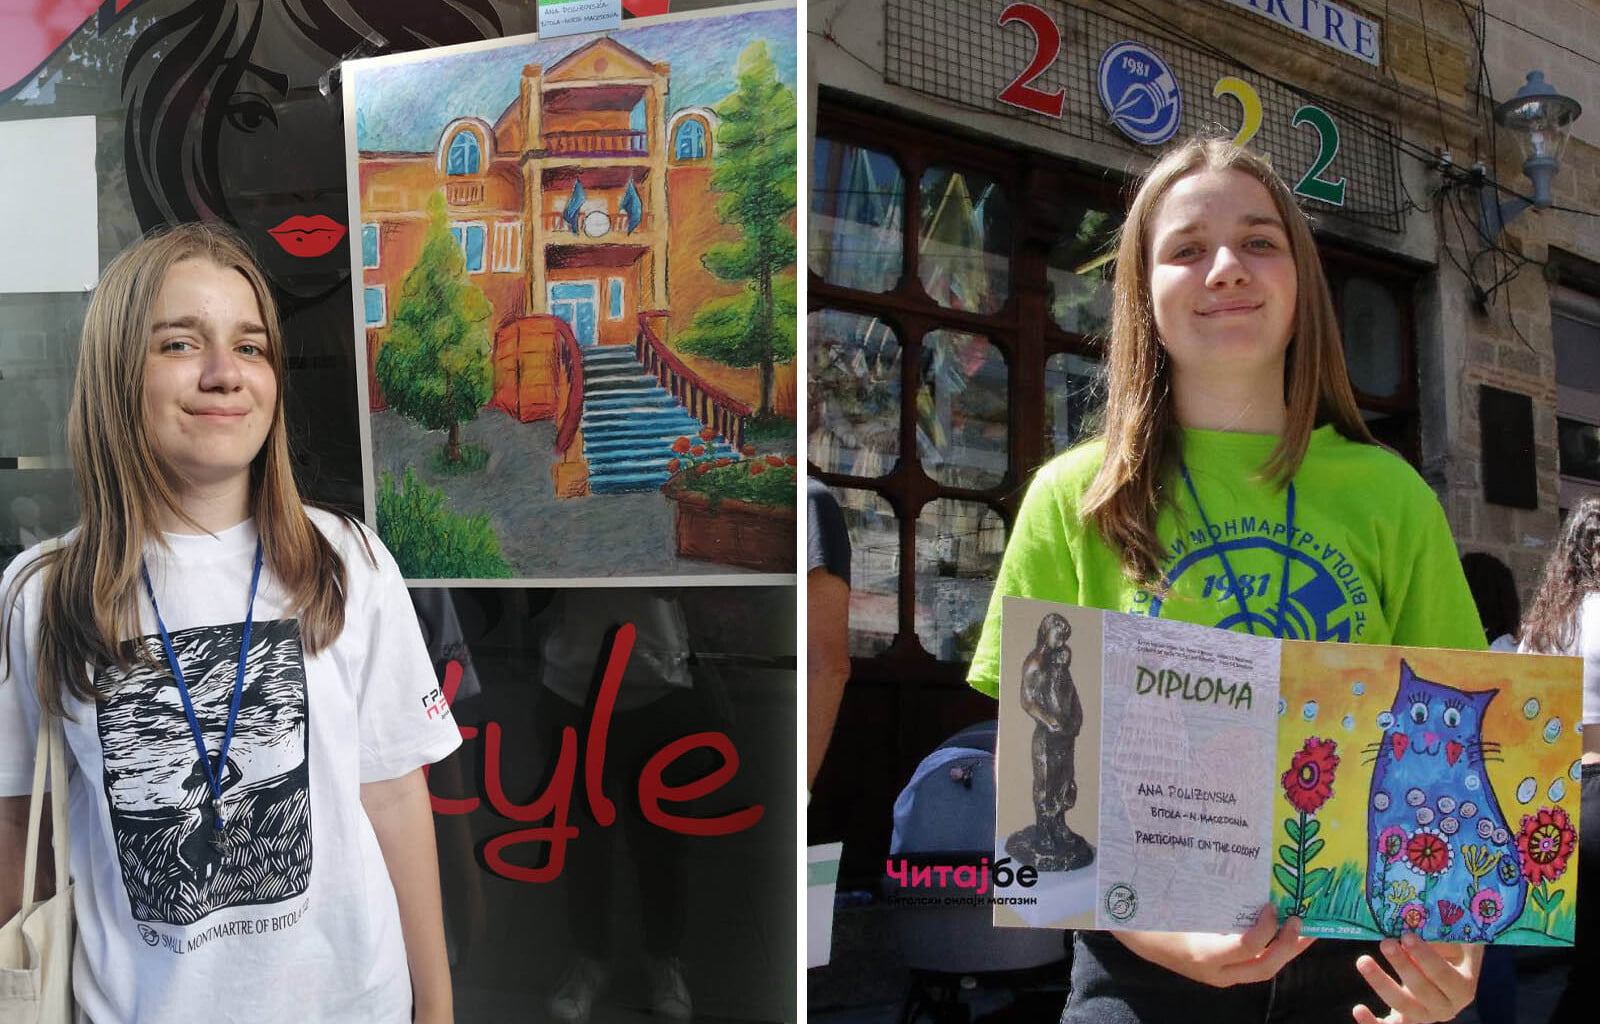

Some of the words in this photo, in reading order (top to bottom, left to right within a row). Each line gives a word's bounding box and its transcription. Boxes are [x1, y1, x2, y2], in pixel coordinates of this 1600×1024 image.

[1121, 56, 1151, 78] 1981
[1202, 573, 1271, 602] 1981
[1136, 665, 1252, 710] DIPLOMA
[1138, 783, 1164, 797] ANA
[1135, 830, 1195, 849] PARTICIPANT
[1197, 839, 1212, 850] ON
[1213, 841, 1230, 853] THE
[161, 933, 185, 955] SMALL
[187, 920, 254, 953] MONTMARTRE
[255, 918, 270, 935] OF
